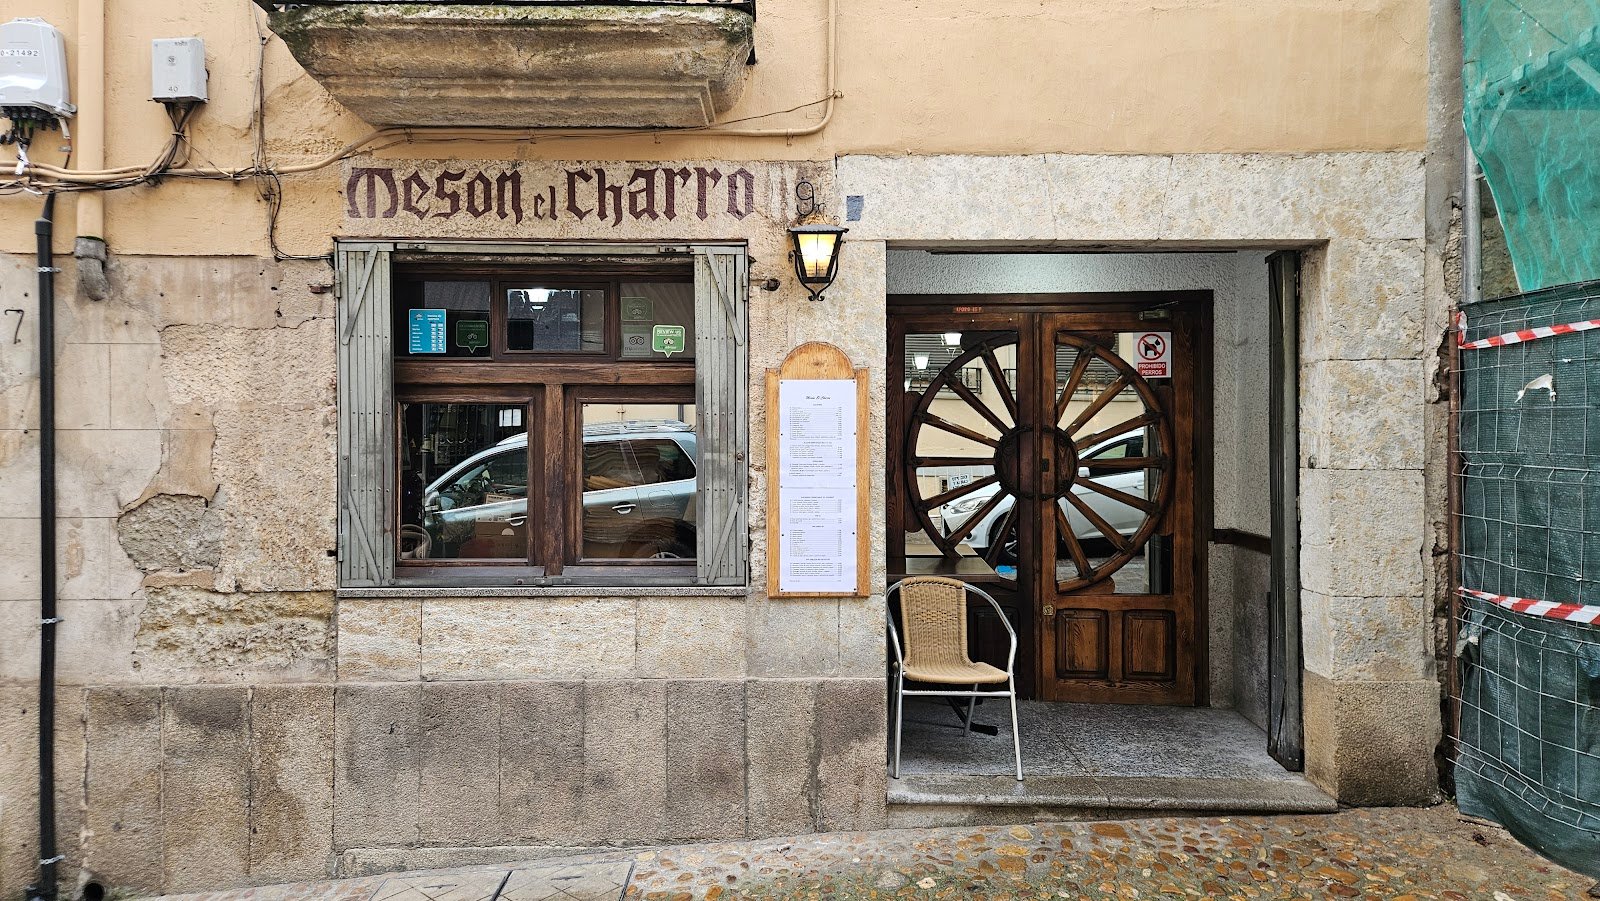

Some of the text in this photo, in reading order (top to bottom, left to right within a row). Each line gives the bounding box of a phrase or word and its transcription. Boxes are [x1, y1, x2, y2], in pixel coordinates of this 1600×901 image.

[533, 186, 558, 221] el
[795, 181, 815, 216] 9
[4, 308, 25, 345] 7
